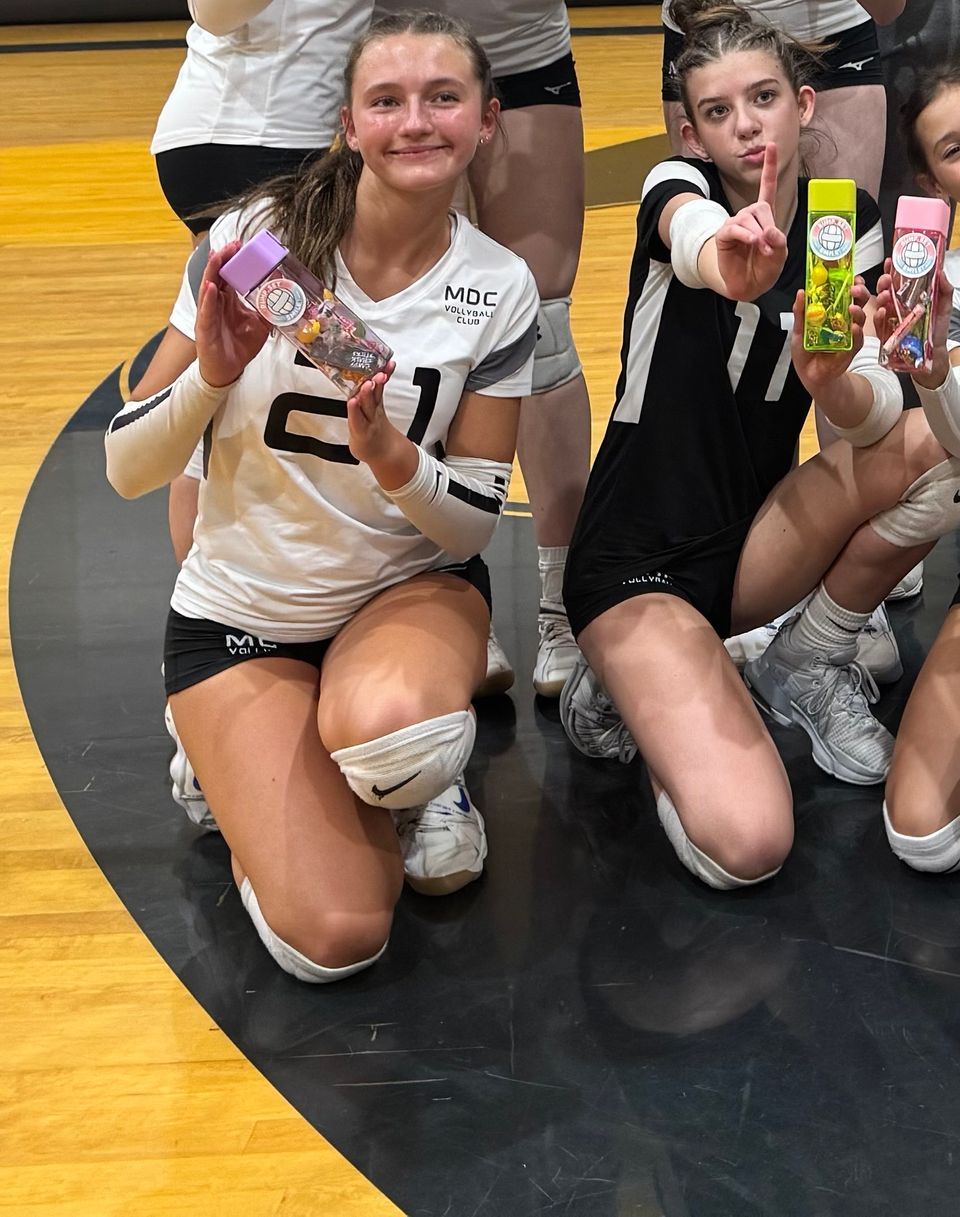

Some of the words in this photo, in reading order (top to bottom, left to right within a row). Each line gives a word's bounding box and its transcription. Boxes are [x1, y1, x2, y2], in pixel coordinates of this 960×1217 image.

[444, 285, 498, 306] MDC
[444, 304, 494, 319] VOLLYBALL
[456, 316, 480, 326] CLUB
